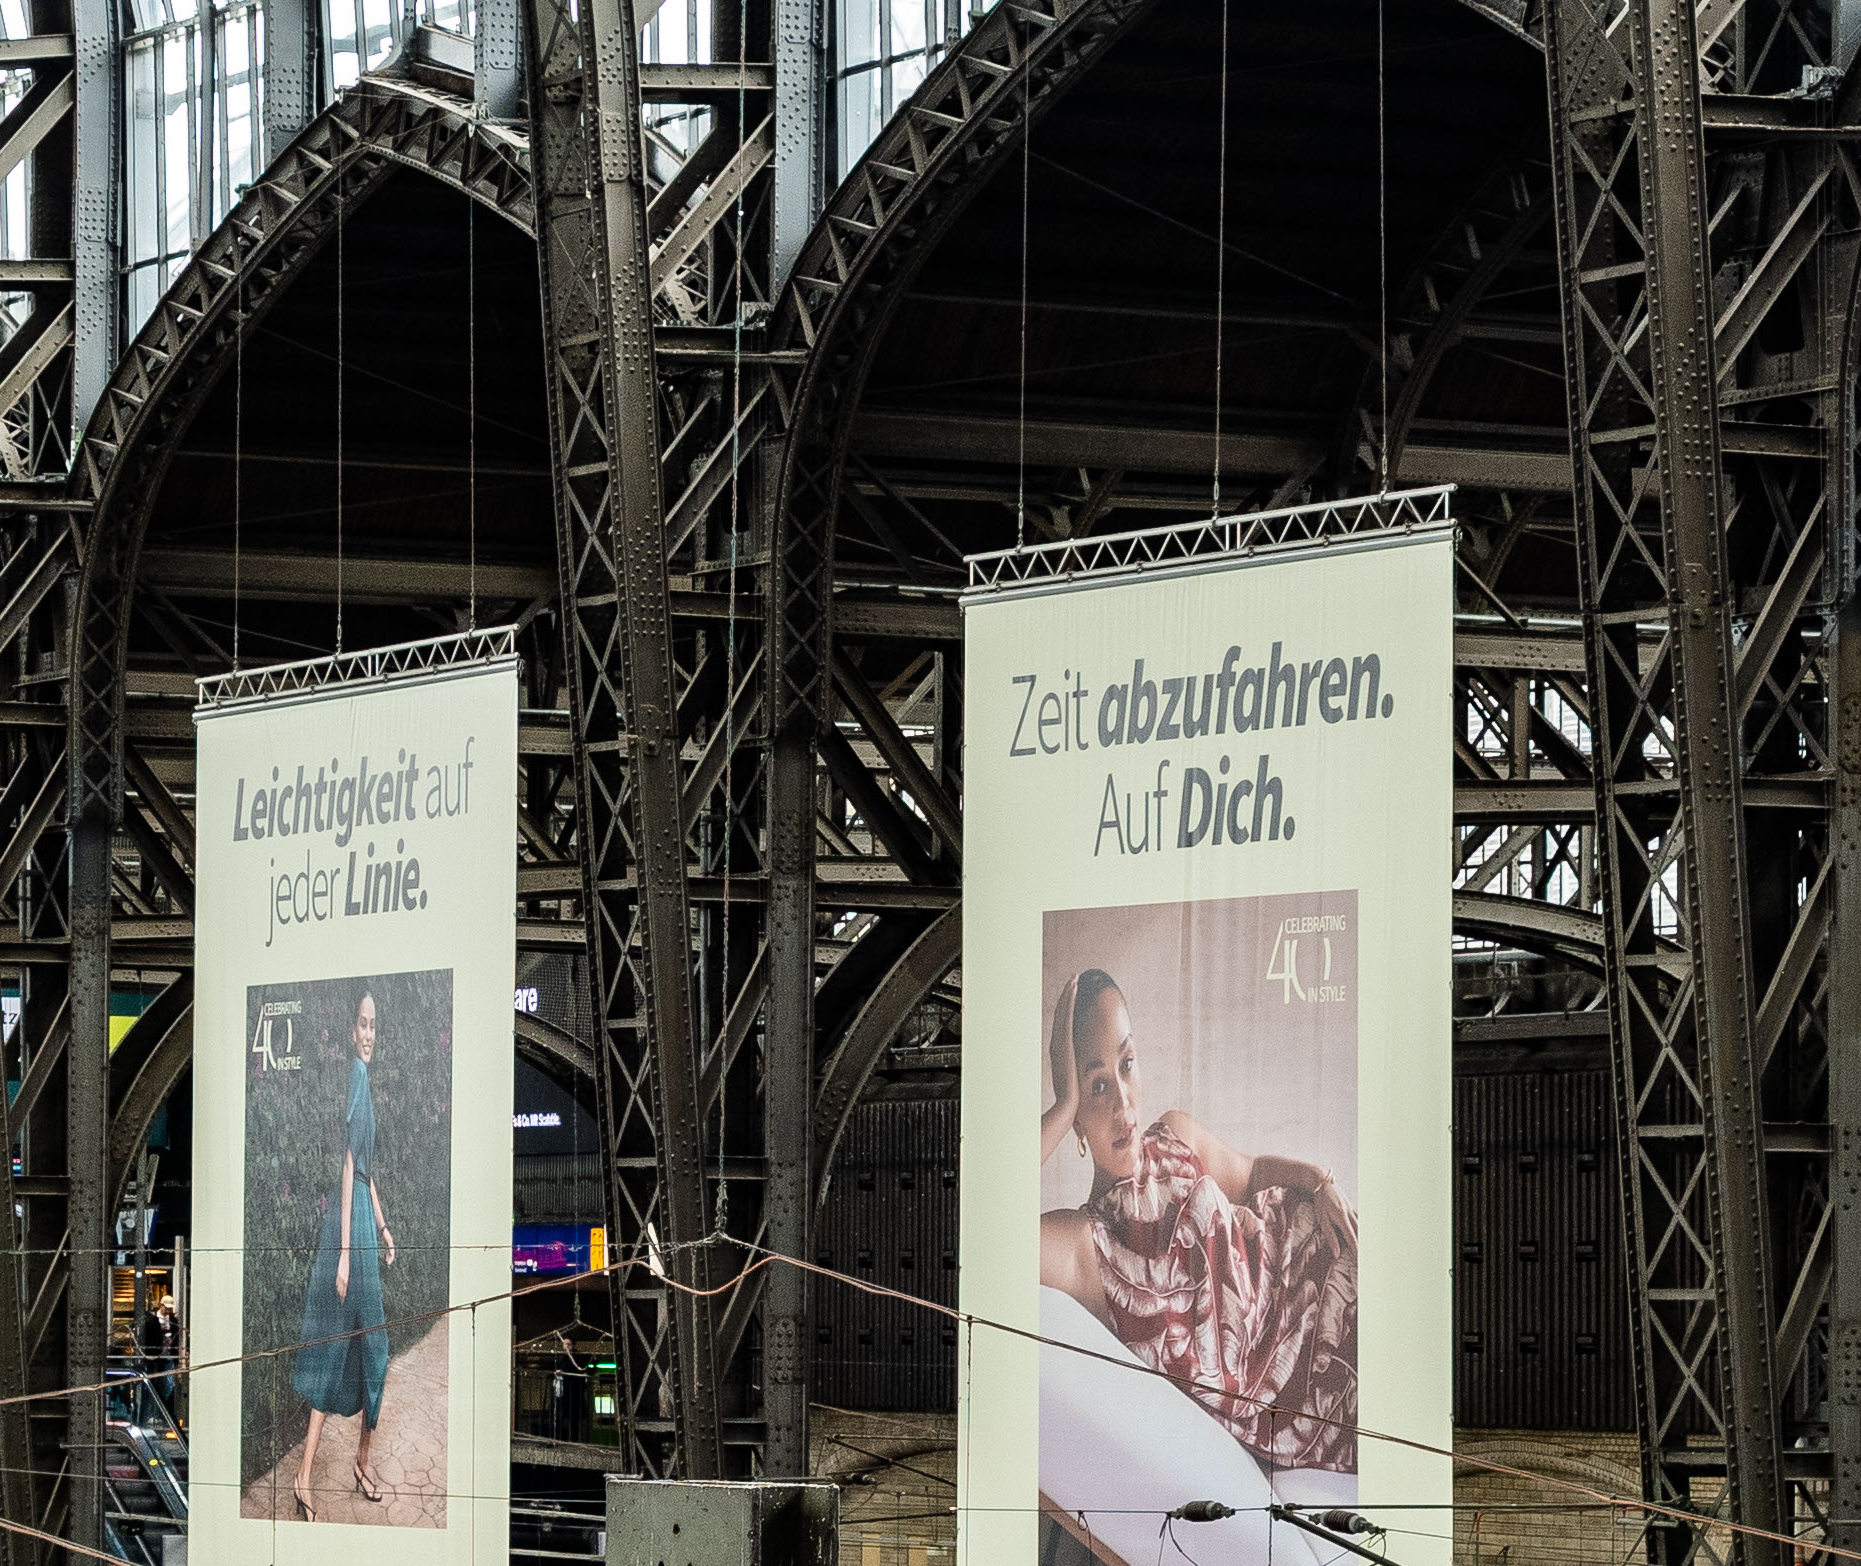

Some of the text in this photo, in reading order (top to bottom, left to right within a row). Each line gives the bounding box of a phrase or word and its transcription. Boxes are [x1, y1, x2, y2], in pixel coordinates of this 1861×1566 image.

[1010, 641, 1394, 757] Zeit abzufahren.
[232, 736, 475, 848] Leichtigkeit auf
[1094, 754, 1296, 857] Auf Dich.
[265, 838, 428, 947] jeder Linie.
[1285, 914, 1346, 934] CELEBRATING
[264, 1000, 302, 1016] CELEBRATING
[1308, 985, 1346, 1003] IN STYLE
